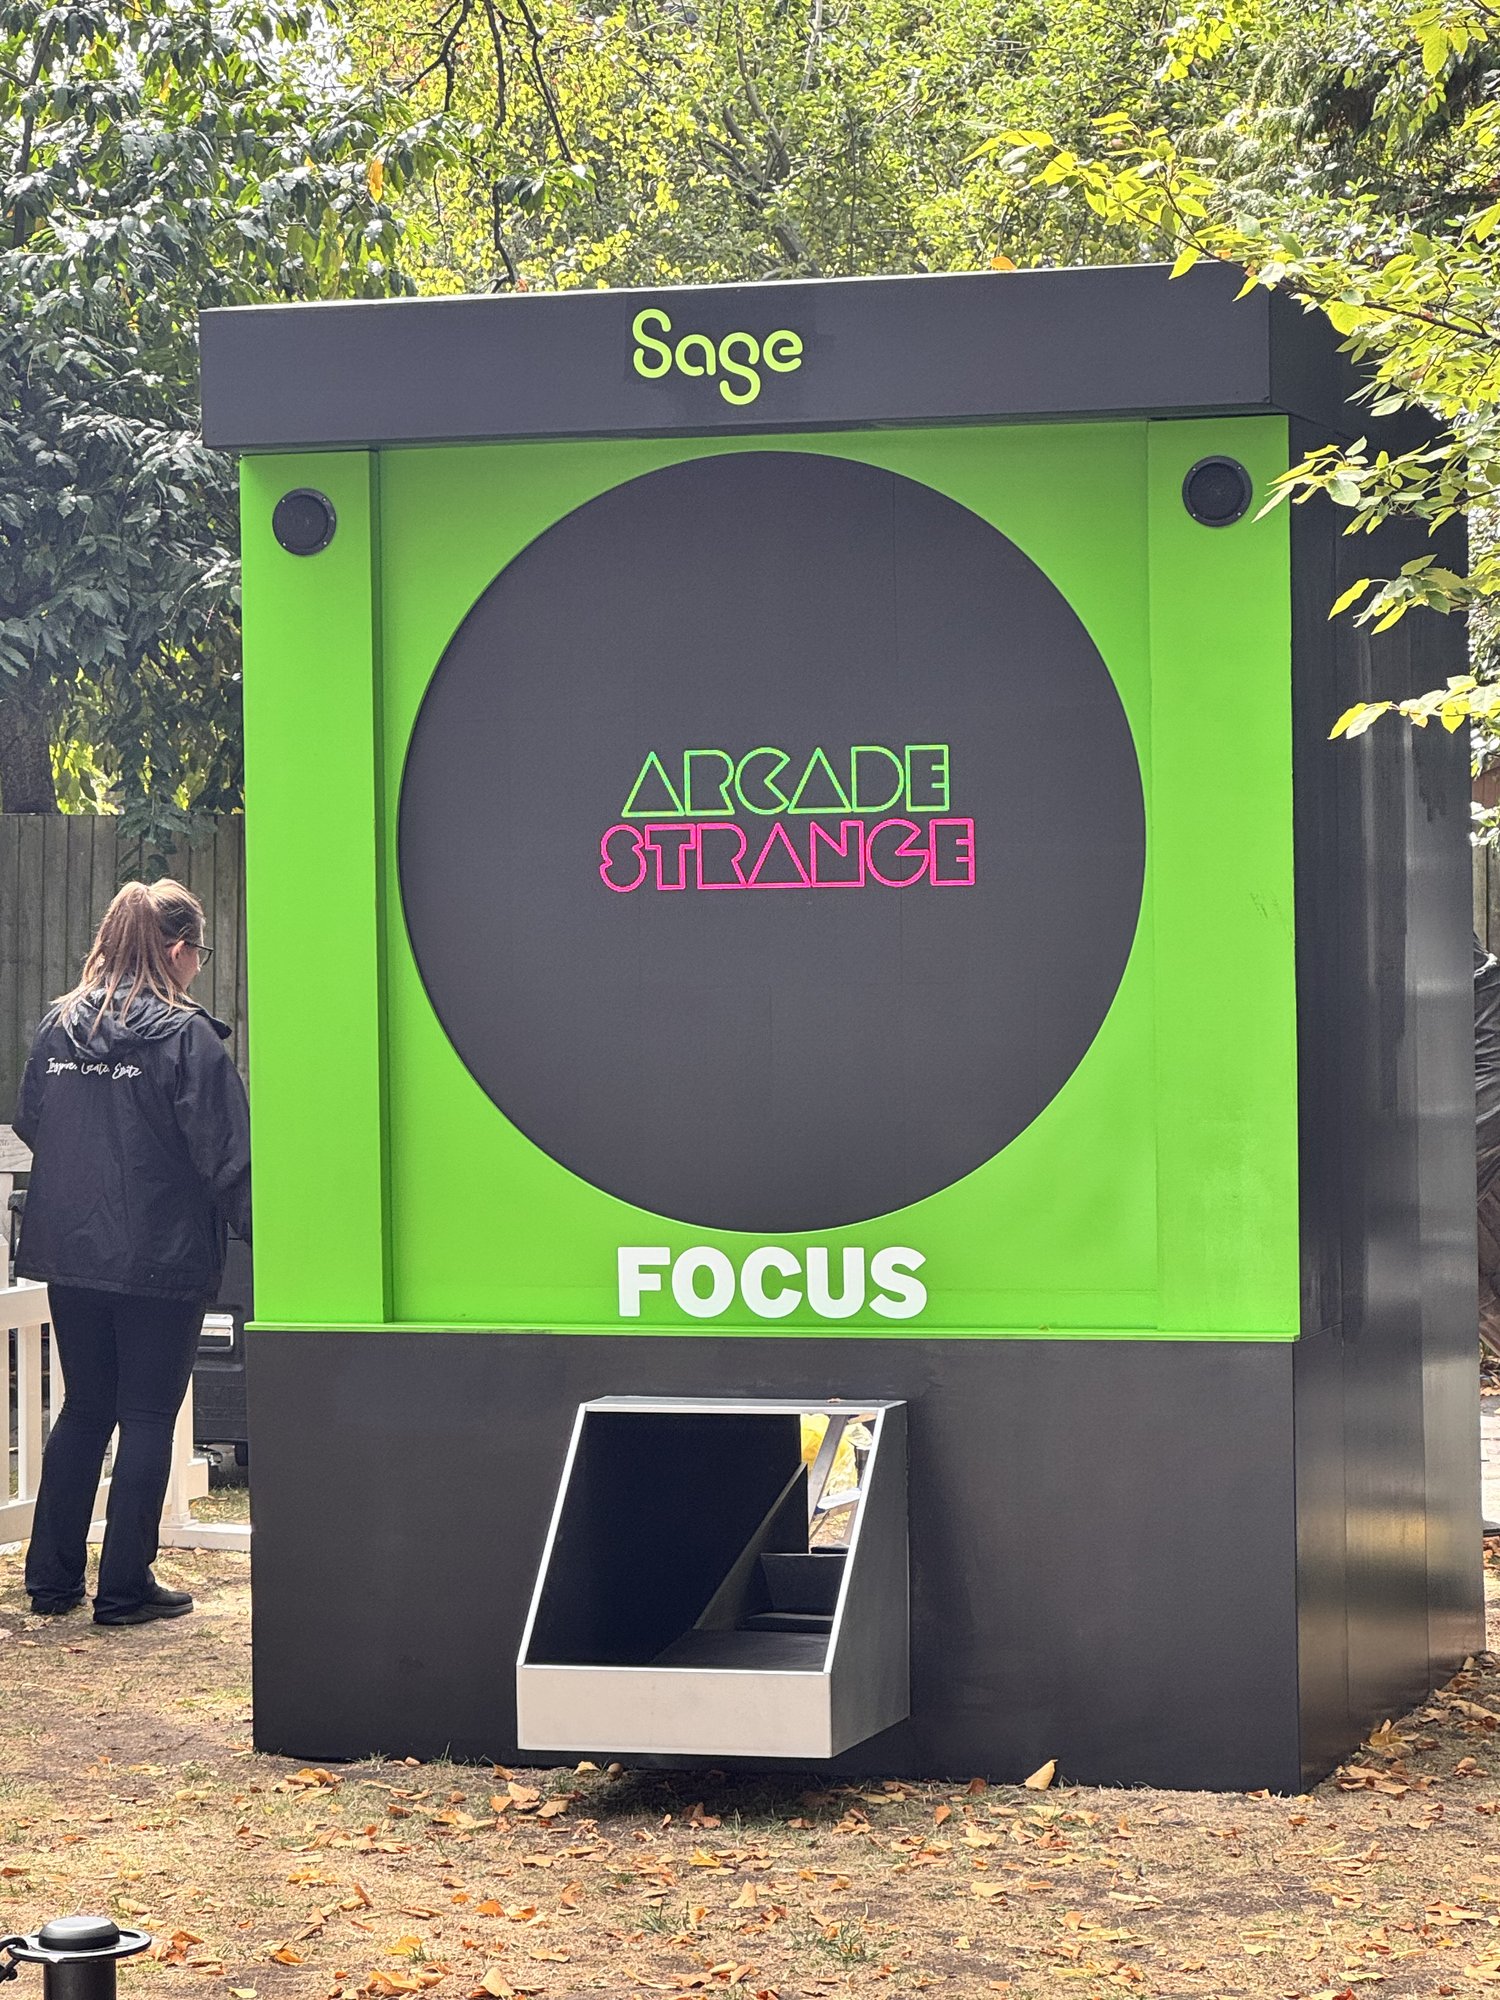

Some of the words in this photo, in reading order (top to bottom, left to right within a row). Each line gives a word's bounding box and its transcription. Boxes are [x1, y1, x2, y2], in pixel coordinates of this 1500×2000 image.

[632, 308, 804, 405] Sage
[621, 744, 950, 818] ARCADE
[598, 818, 976, 894] STRANGE
[617, 1246, 928, 1319] FOCUS
